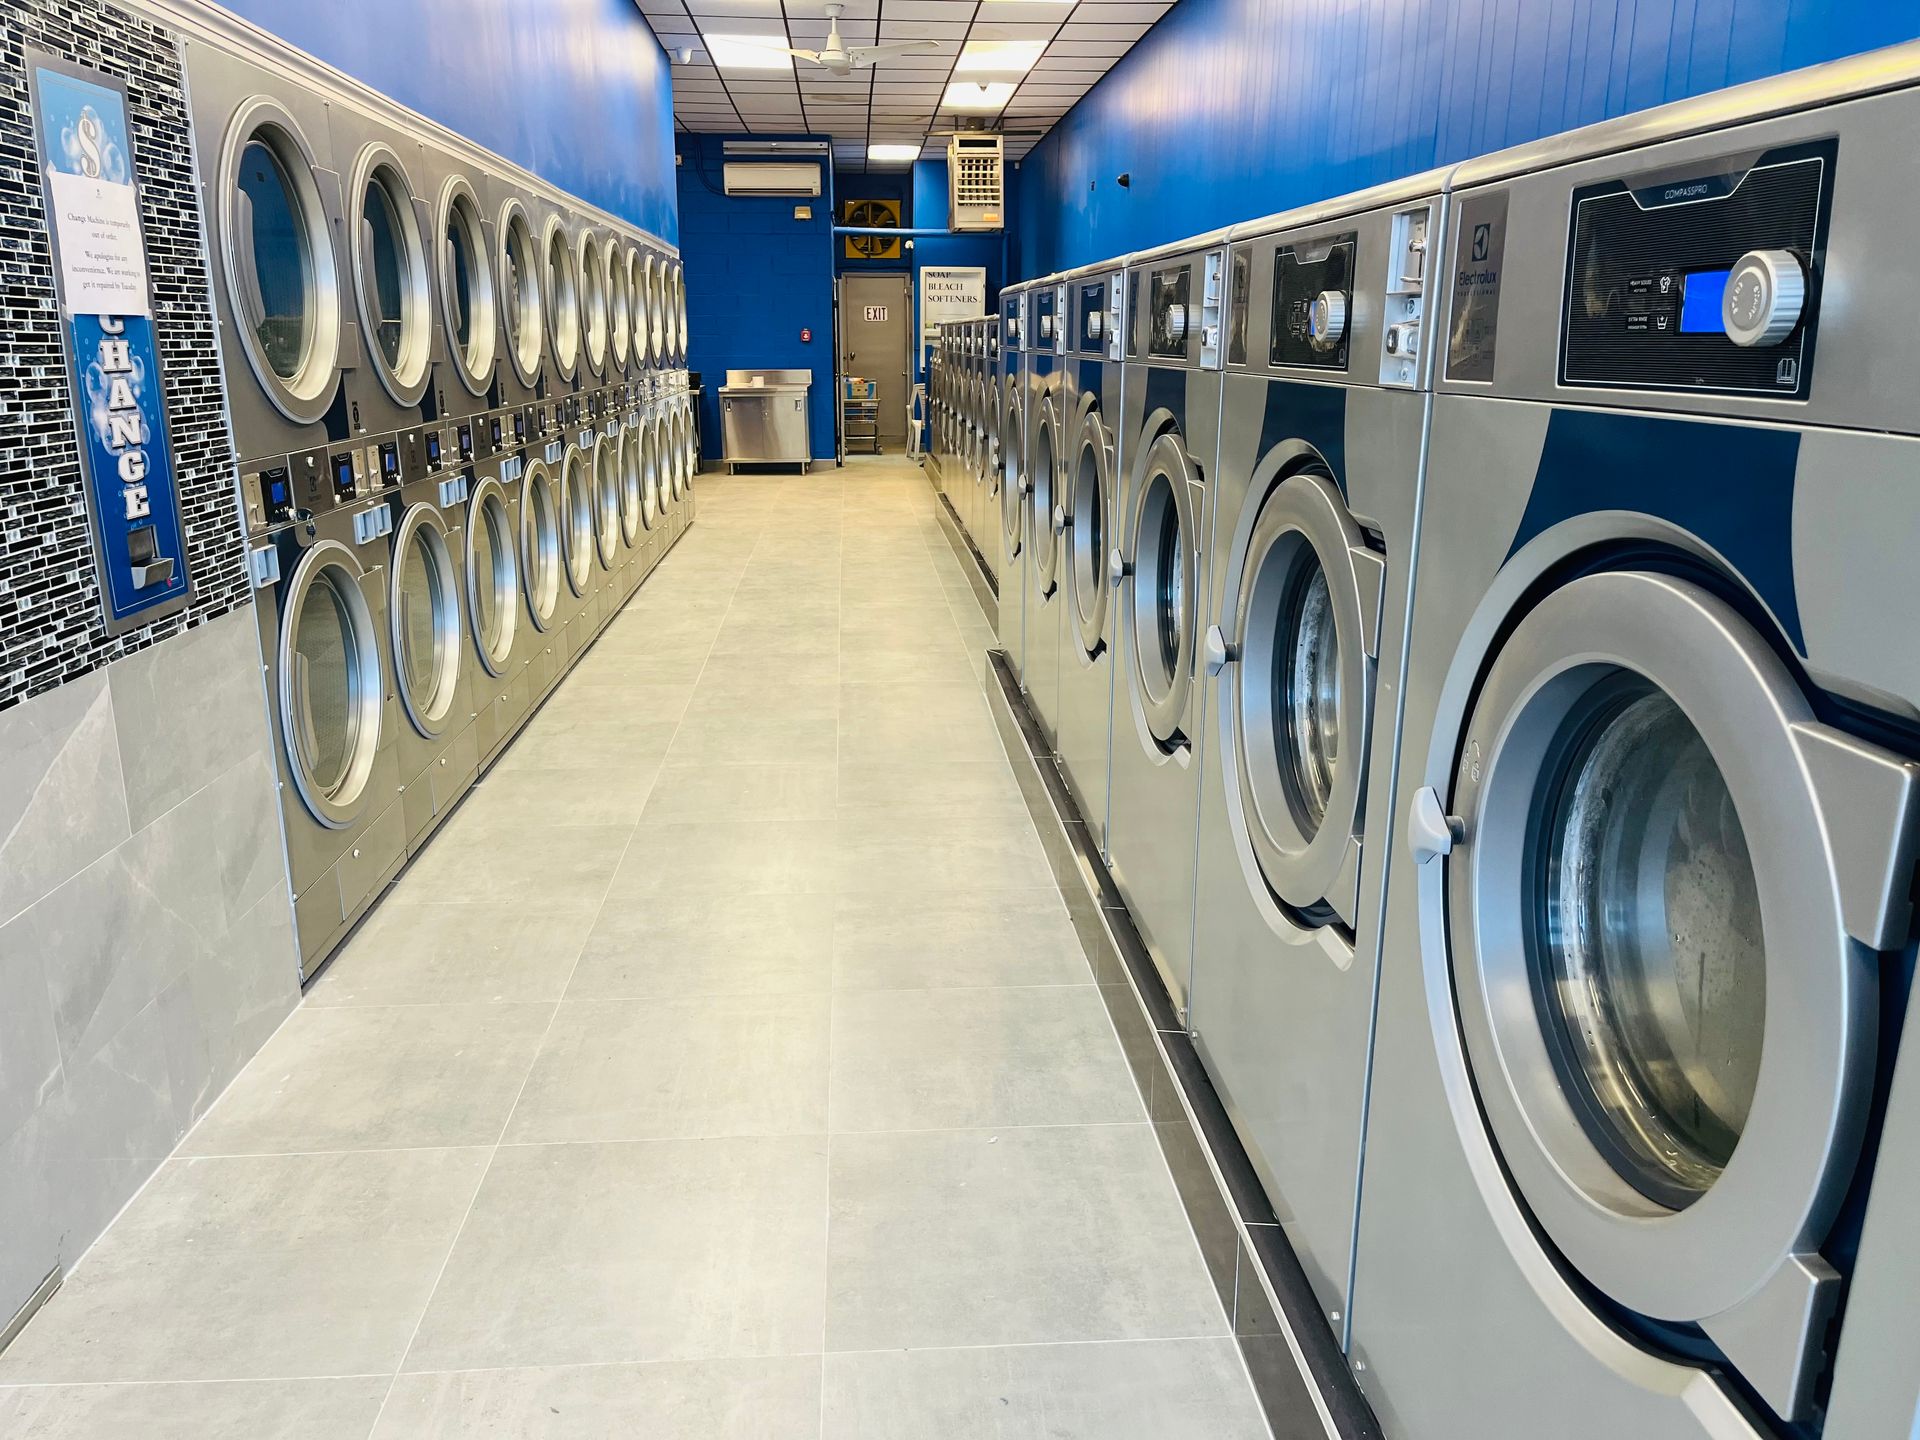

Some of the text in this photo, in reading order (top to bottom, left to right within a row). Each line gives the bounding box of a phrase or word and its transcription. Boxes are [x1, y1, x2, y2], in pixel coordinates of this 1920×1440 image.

[1664, 184, 1708, 200] COMPASSPRO
[67, 212, 87, 224] Change
[87, 215, 105, 225] Machine
[85, 250, 93, 259] We
[106, 266, 114, 275] We
[121, 270, 137, 279] working
[1459, 269, 1497, 286] Electrolux
[82, 281, 91, 289] get
[96, 282, 114, 291] repaired
[928, 283, 963, 291] BLEACH
[928, 295, 978, 304] SOFTENERS
[866, 307, 886, 321] EXIT
[99, 315, 150, 521] CHANGE
